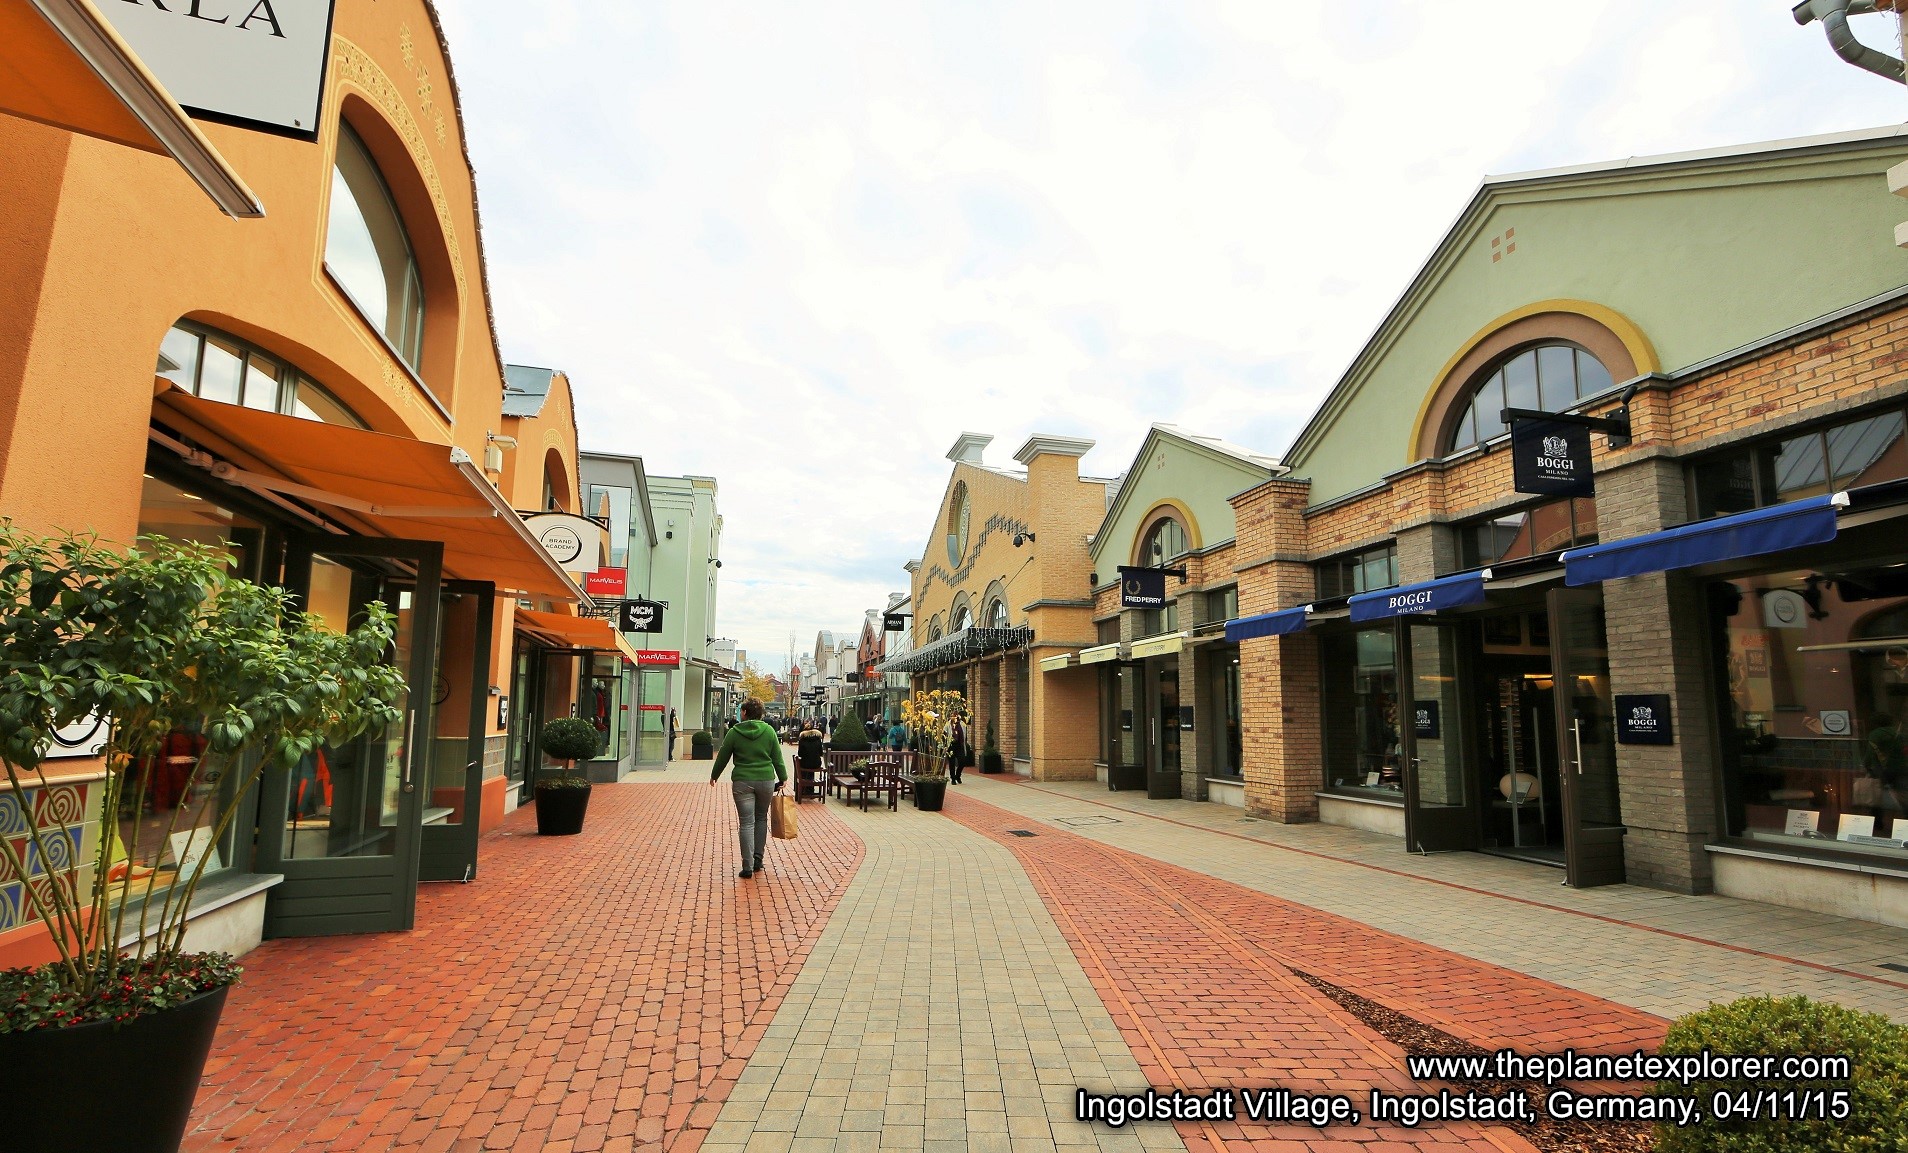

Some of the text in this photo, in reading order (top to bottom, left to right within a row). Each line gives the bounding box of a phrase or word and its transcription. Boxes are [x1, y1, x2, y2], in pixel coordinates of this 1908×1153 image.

[1537, 456, 1574, 470] BOGGI
[589, 577, 623, 585] MARVELIS
[1125, 595, 1162, 604] FRED PERRY
[1388, 590, 1433, 609] BOGGI
[629, 605, 654, 615] MCM
[1397, 605, 1424, 614] MILANO
